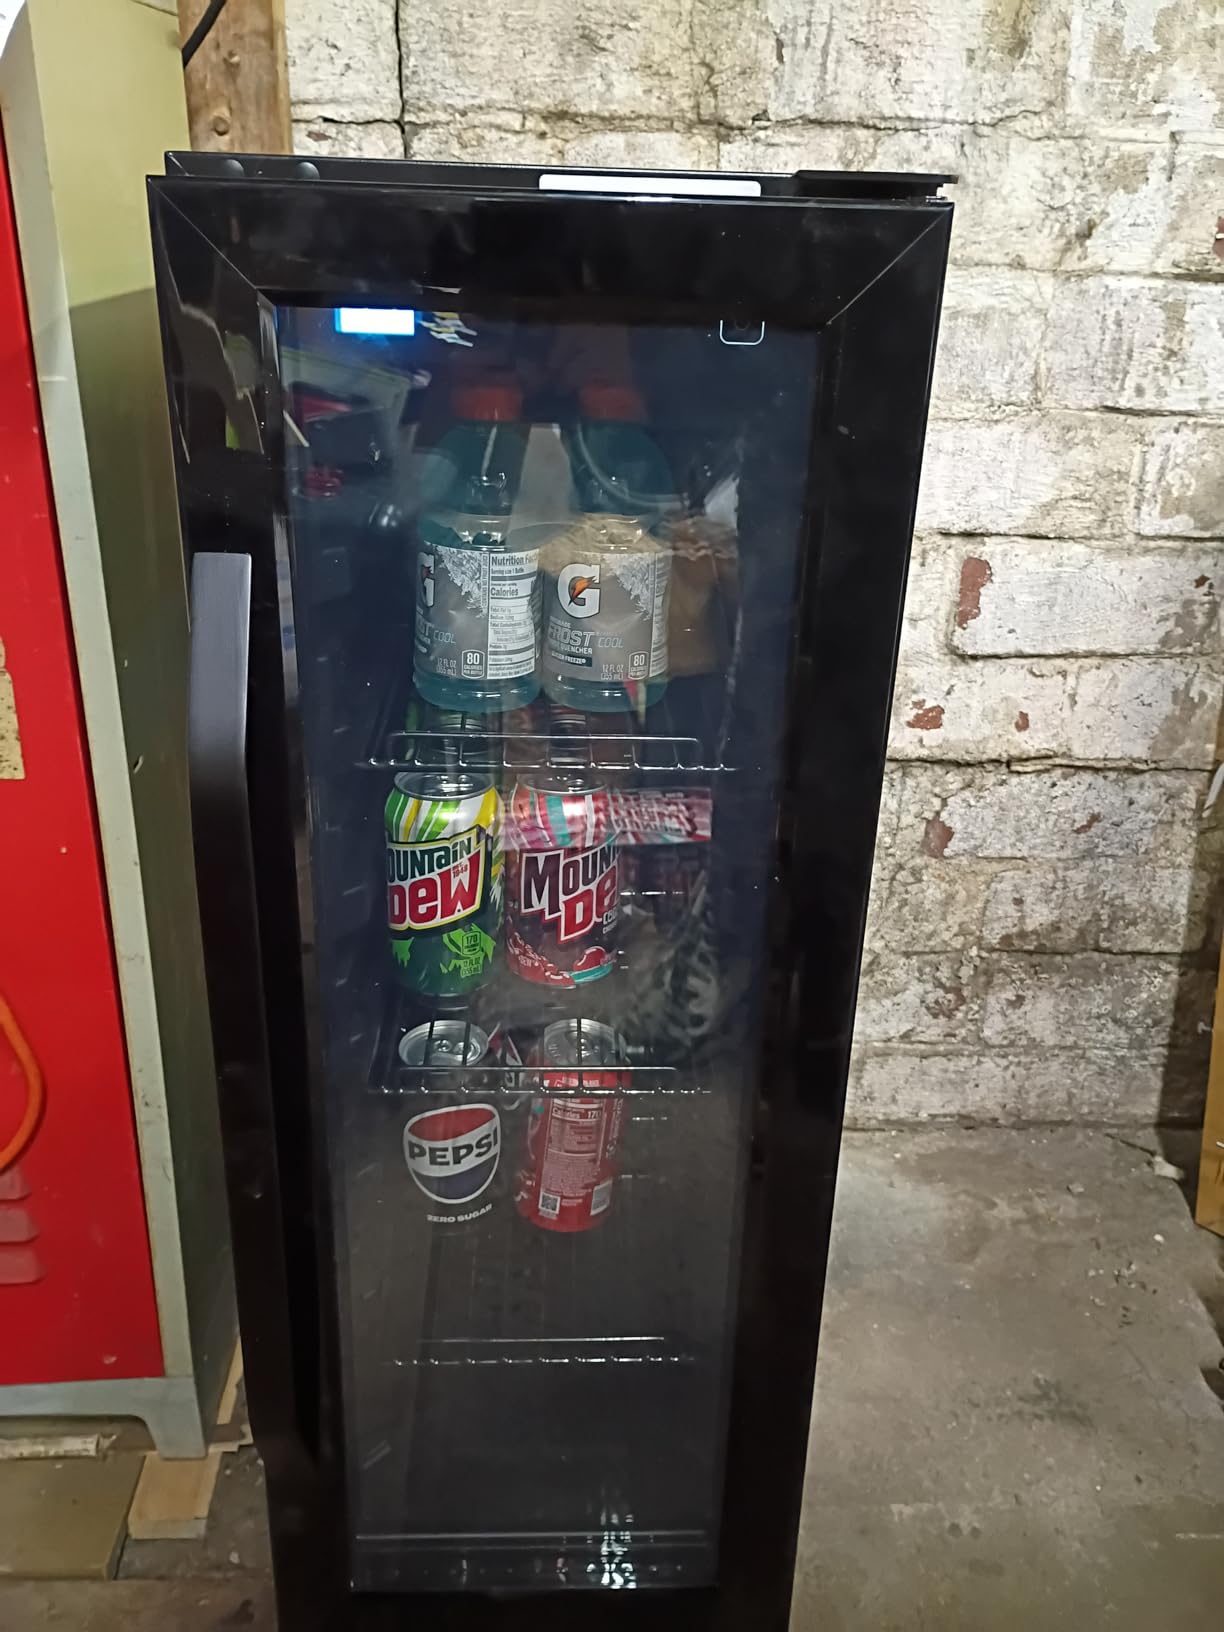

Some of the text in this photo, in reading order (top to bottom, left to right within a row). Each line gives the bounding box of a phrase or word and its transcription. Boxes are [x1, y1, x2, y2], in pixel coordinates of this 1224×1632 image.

[491, 555, 524, 566] Nutrition
[491, 586, 519, 597] Calories
[558, 563, 602, 618] G
[597, 636, 625, 649] COOL
[466, 652, 480, 665] 80
[633, 654, 645, 666] 80
[561, 864, 618, 938] De
[407, 1125, 498, 1166] PEPSI
[426, 1203, 493, 1223] ZERO SUGAR
